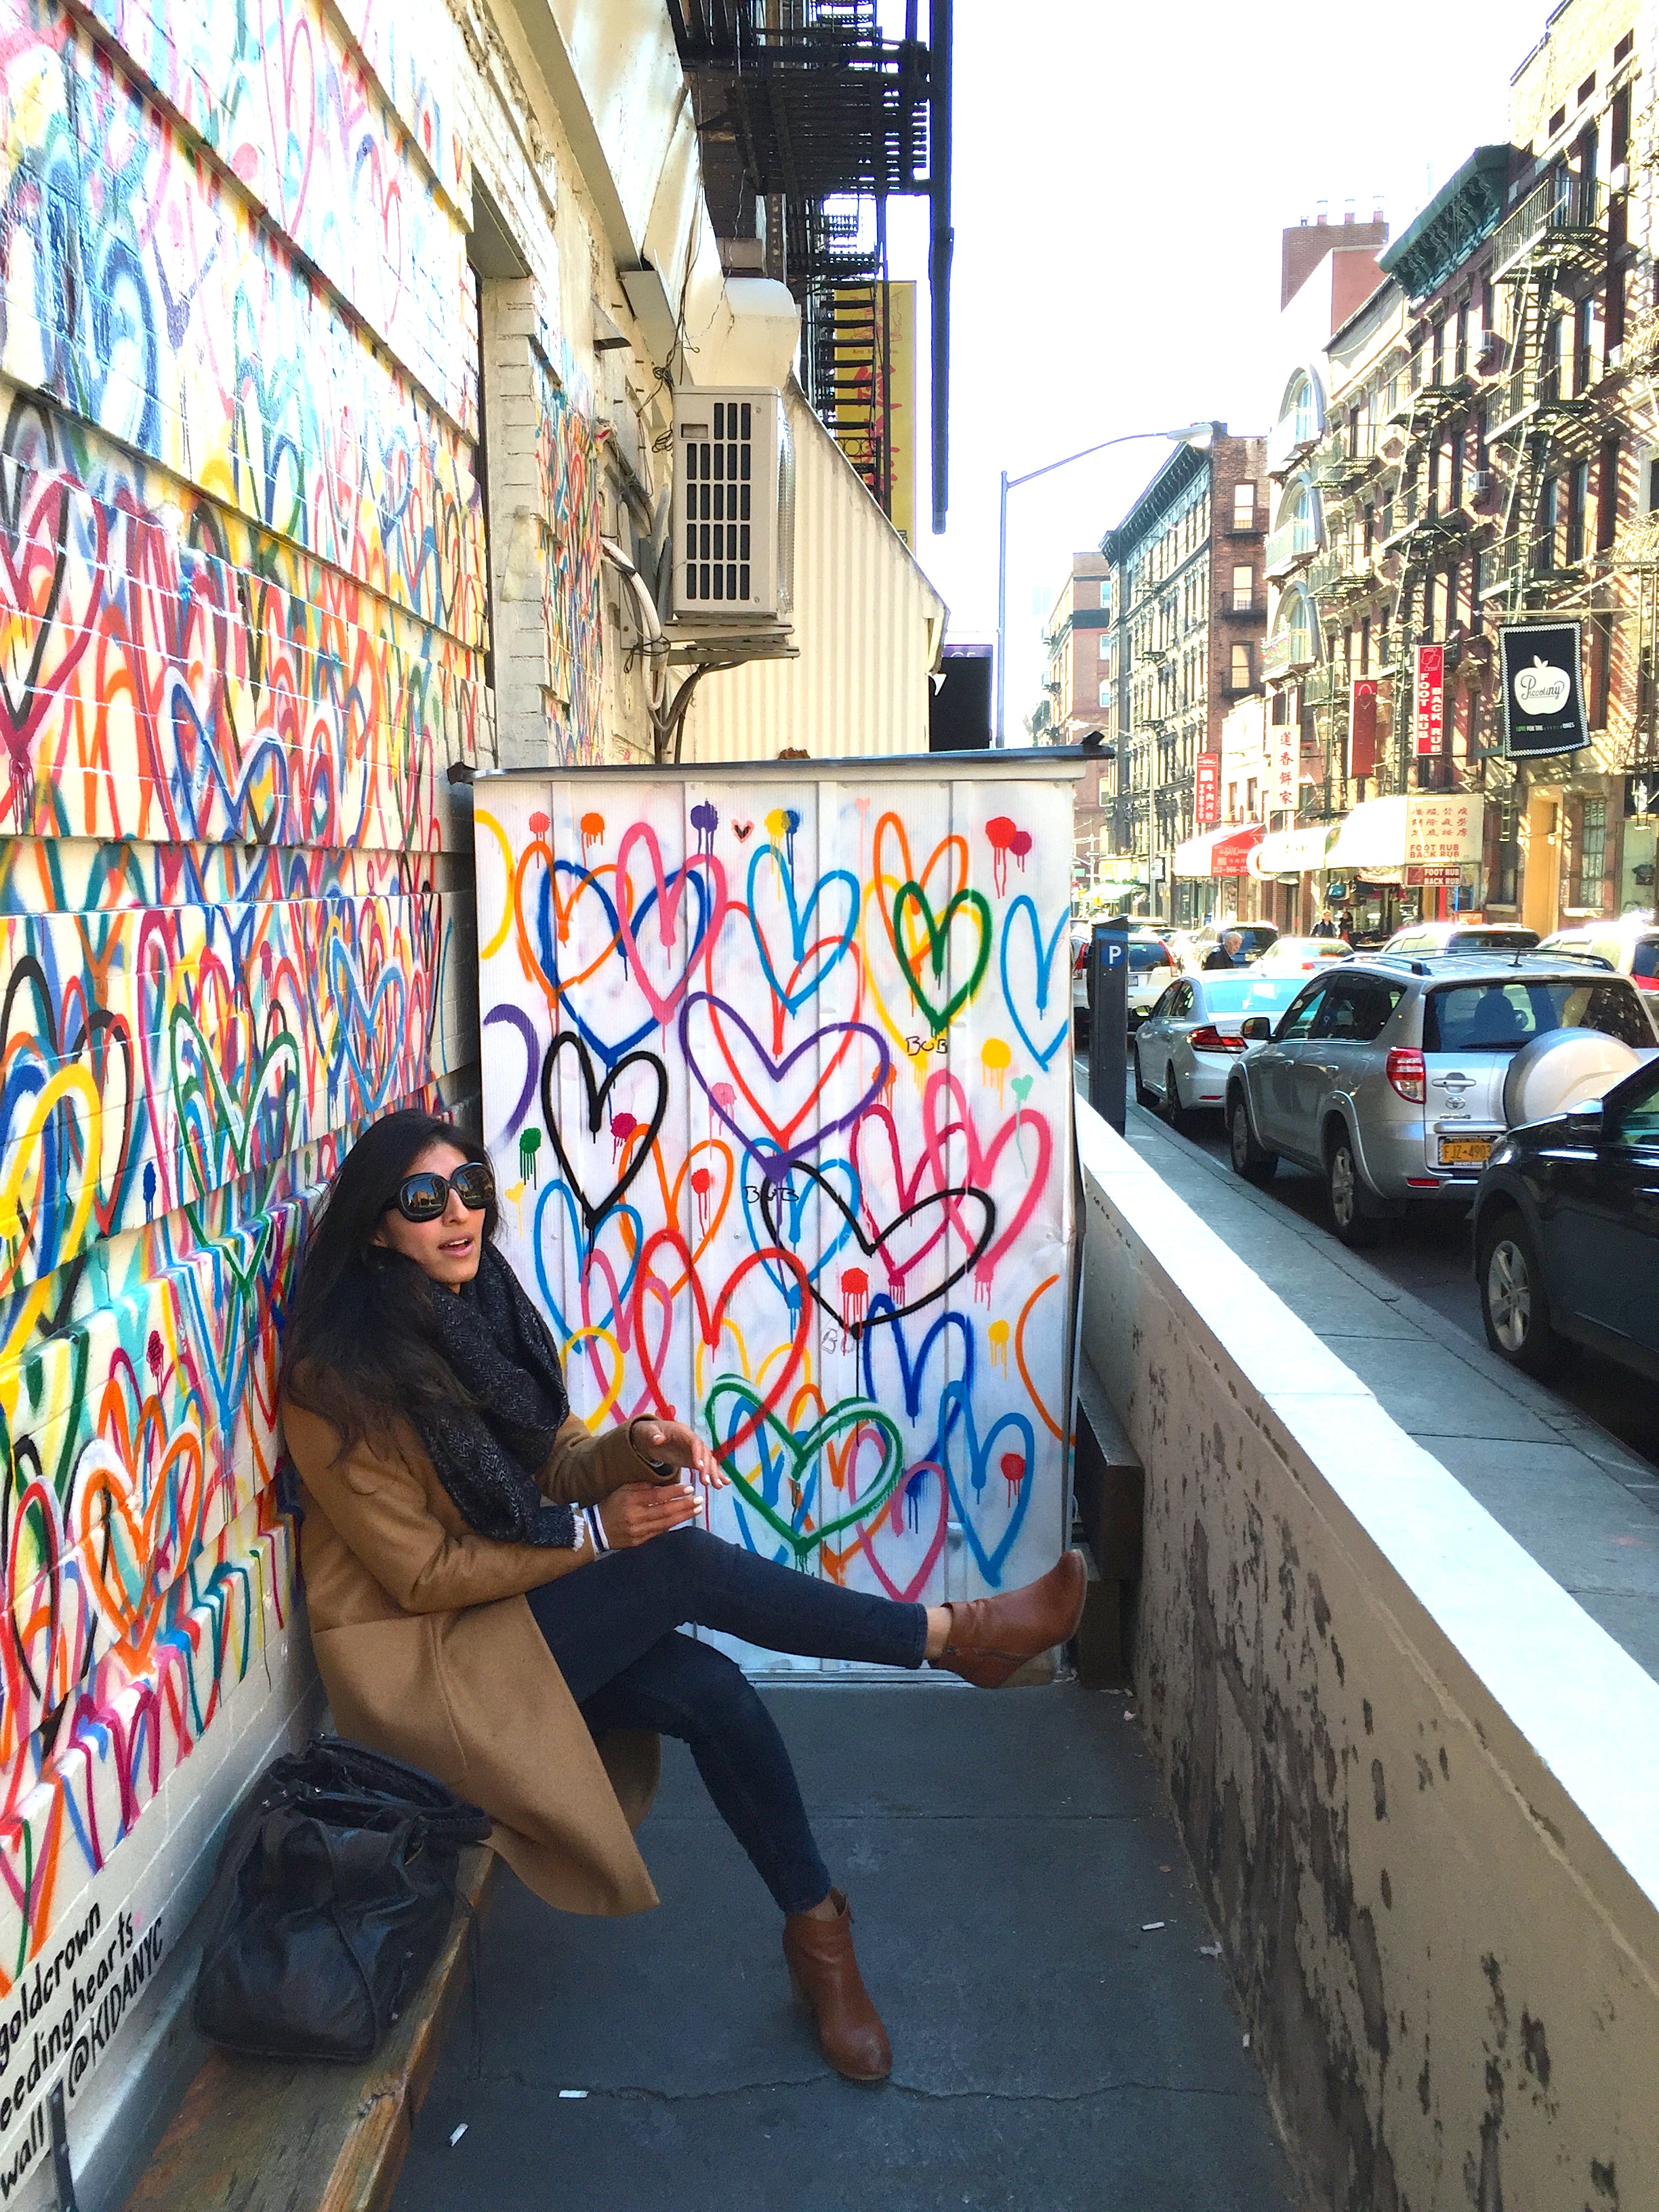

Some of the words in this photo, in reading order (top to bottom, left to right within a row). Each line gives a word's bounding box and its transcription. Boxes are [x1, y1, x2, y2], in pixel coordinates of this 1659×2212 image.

[1419, 673, 1430, 707] FOOT
[1431, 687, 1442, 720] BACK
[1418, 714, 1429, 739] RUB
[1431, 728, 1441, 752] RUB
[1109, 945, 1122, 964] P
[0, 2100, 45, 2201] wall
